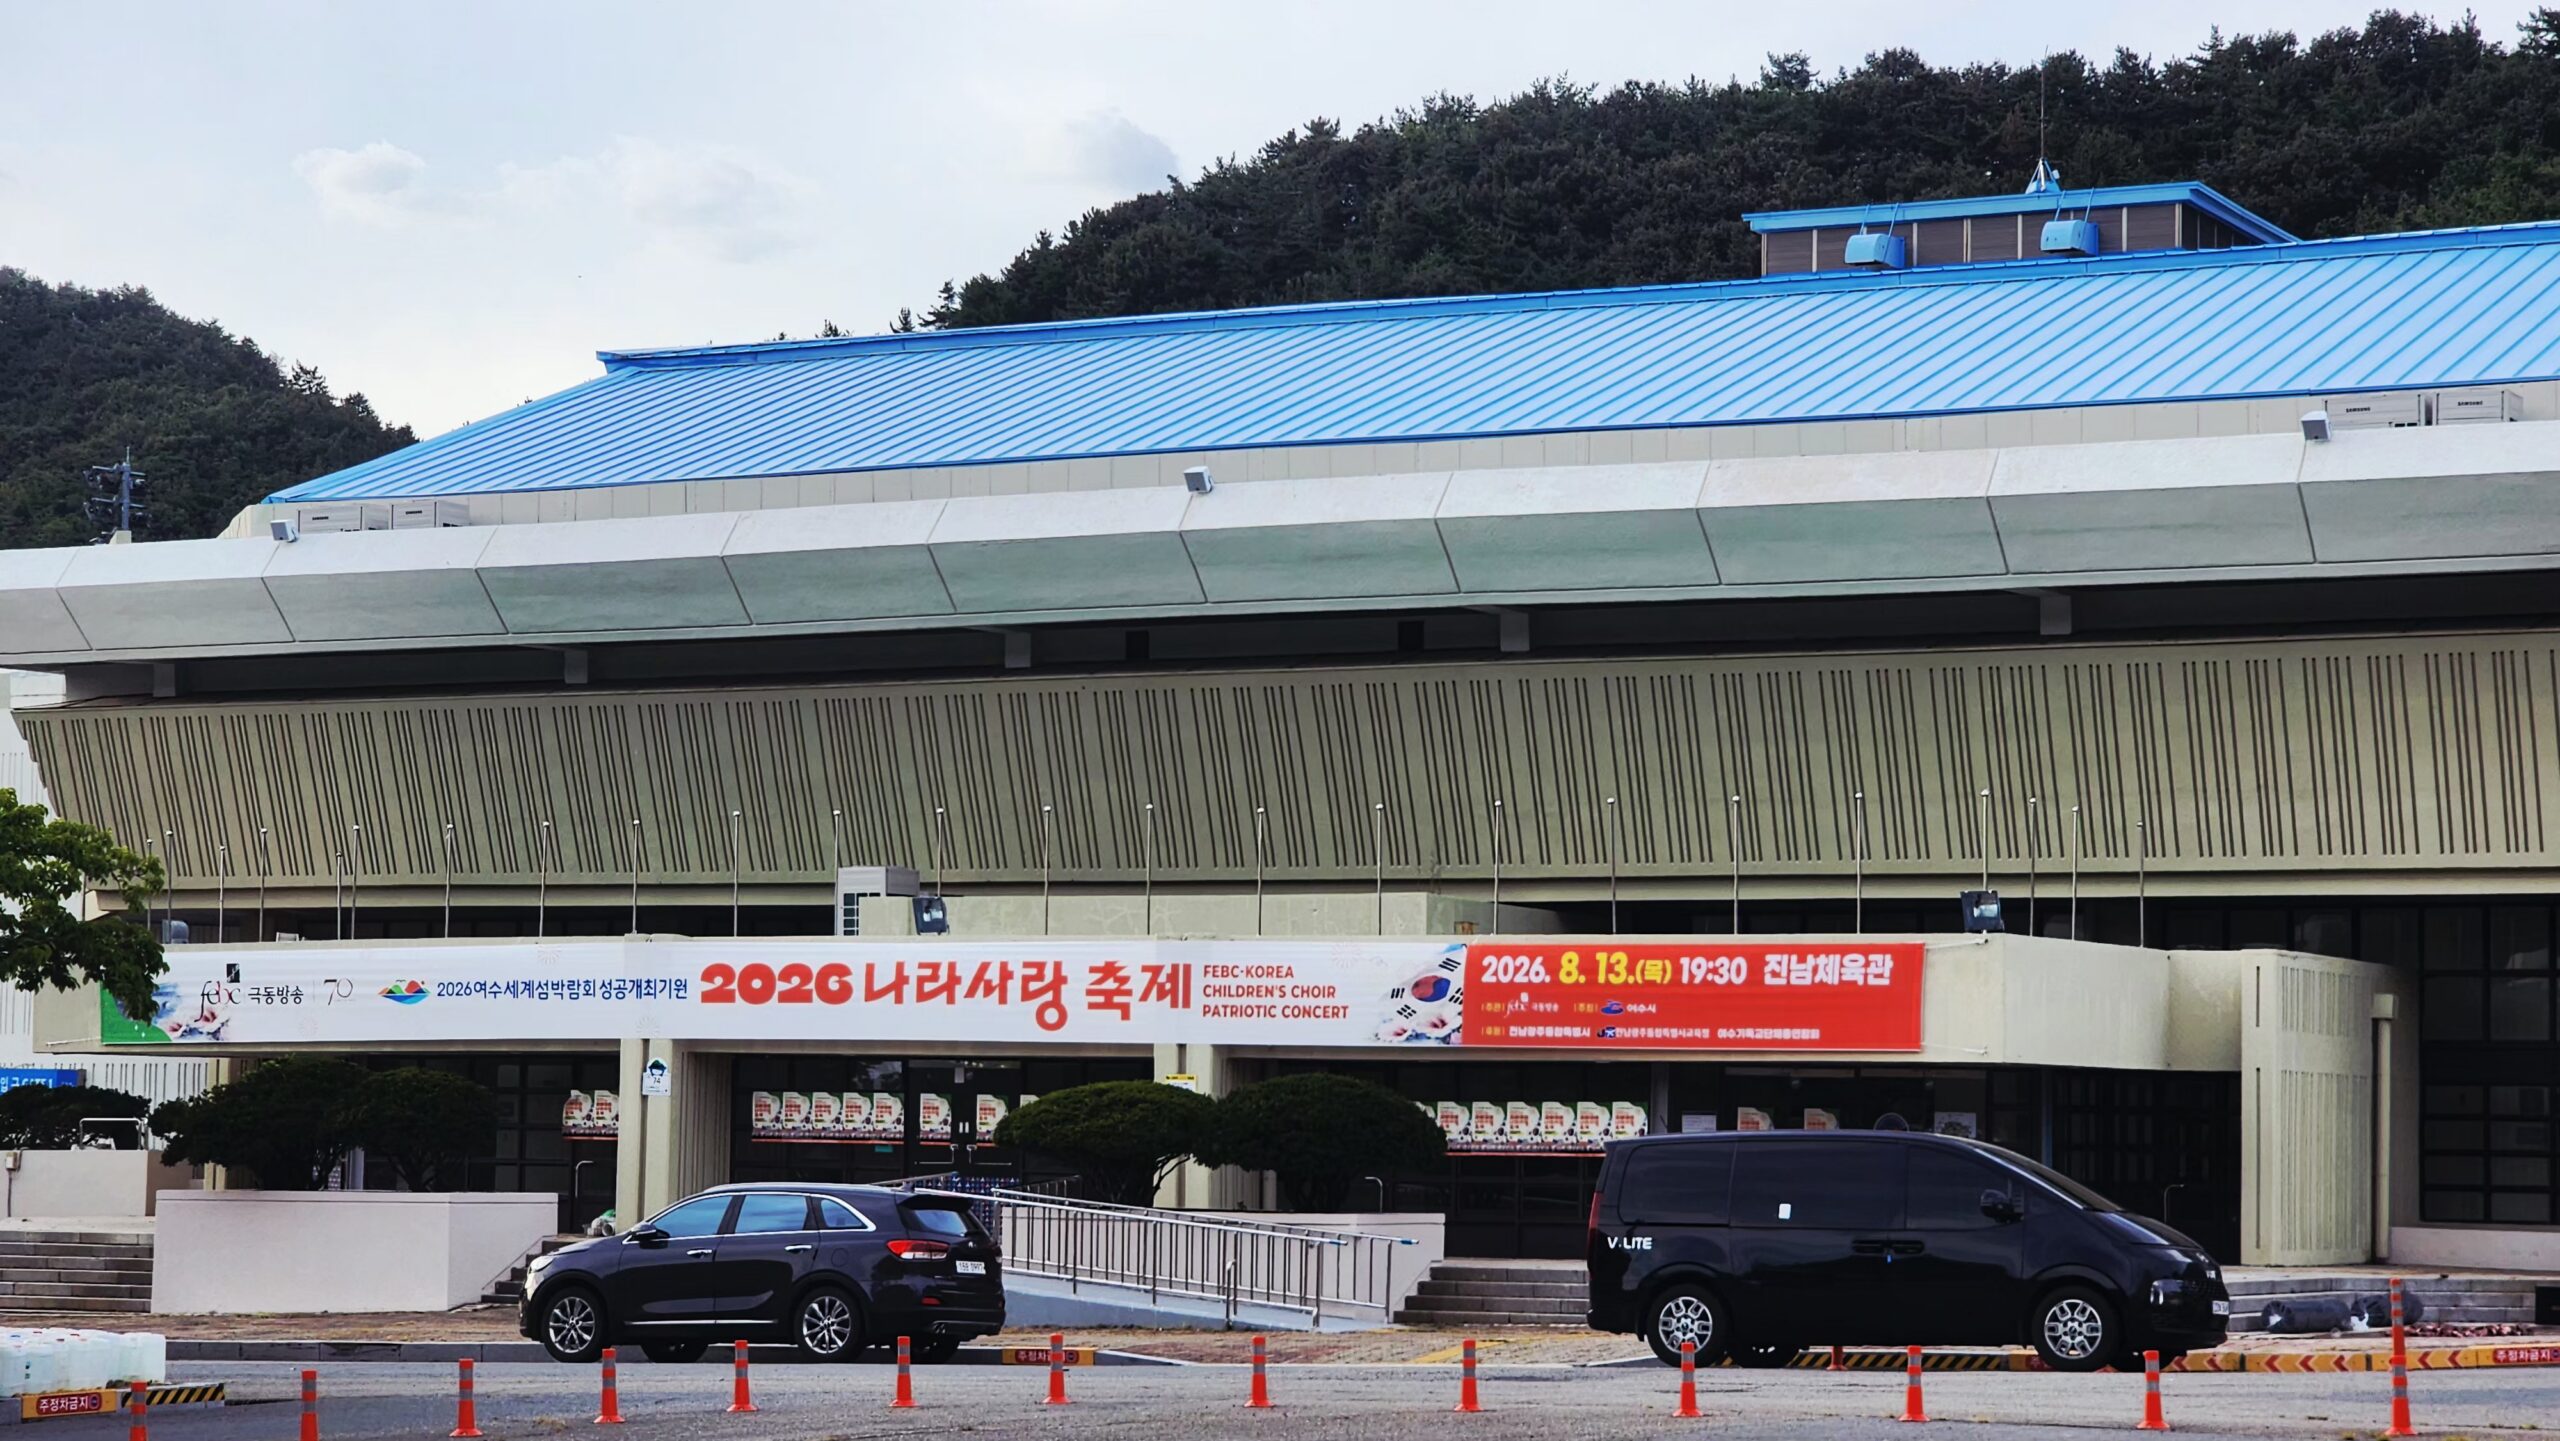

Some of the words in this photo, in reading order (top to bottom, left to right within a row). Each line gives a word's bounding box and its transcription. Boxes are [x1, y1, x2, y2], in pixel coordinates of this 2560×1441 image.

[1481, 955, 1551, 984] 2026.
[1559, 951, 1586, 985] 8.
[1680, 956, 1748, 985] 19:30
[1763, 953, 1895, 986] 진남체육관
[248, 985, 304, 1005] 극동방송
[700, 962, 854, 1005] 2026
[864, 961, 1069, 1032] 나라사랑
[1085, 960, 1192, 1021] 축제
[1203, 984, 1287, 998] CHILDREN'S
[1292, 985, 1336, 999] CHOIR
[1203, 1004, 1277, 1018] PATRIOTIC
[1281, 1005, 1349, 1019] CONCERT
[2496, 1349, 2550, 1363] 주정차금지
[40, 1395, 89, 1413] 주정차금지
